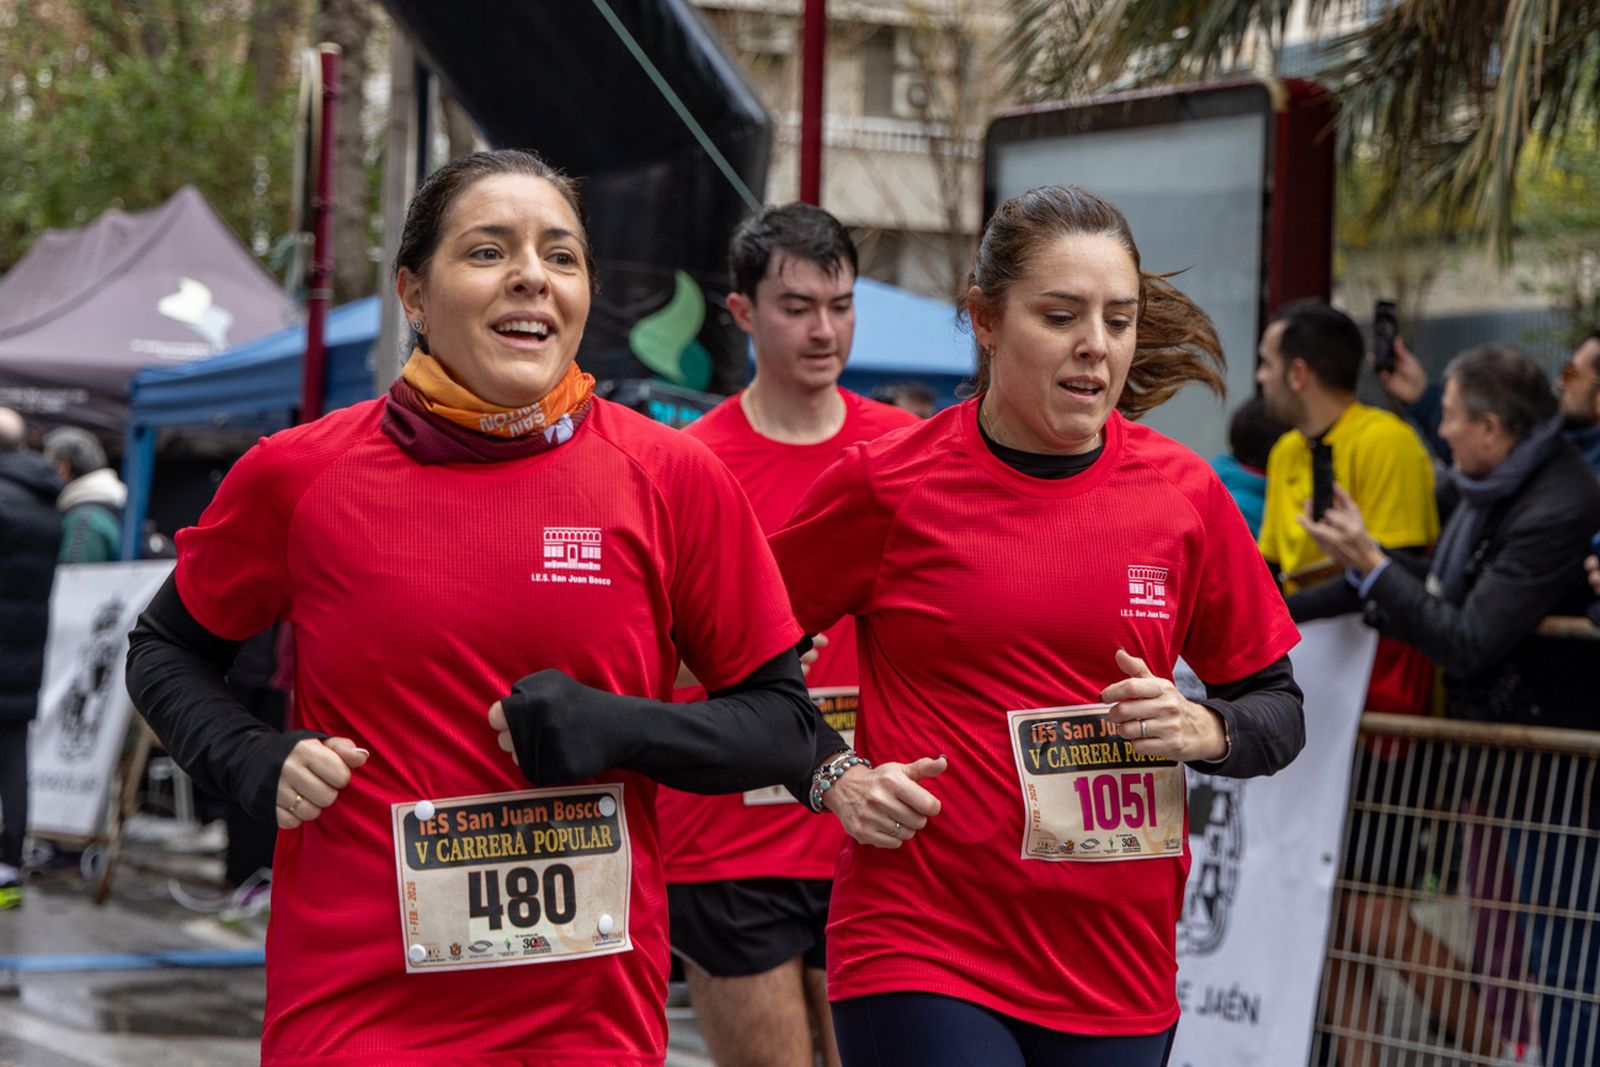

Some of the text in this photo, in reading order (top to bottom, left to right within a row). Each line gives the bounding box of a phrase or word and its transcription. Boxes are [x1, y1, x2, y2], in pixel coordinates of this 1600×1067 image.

[551, 574, 567, 582] San
[568, 574, 587, 584] Juan
[588, 575, 612, 586] Bosco
[1061, 721, 1095, 741] San
[1099, 718, 1121, 737] Ju
[1029, 748, 1041, 769] V
[1047, 742, 1122, 769] CARRERA
[1073, 772, 1158, 832] 1051
[419, 812, 450, 836] IES
[456, 810, 495, 832] San
[501, 805, 548, 827] Juan
[415, 824, 614, 864] V CARRERA POPULAR
[468, 863, 577, 930] 480
[1194, 981, 1262, 1026] JAÉN
